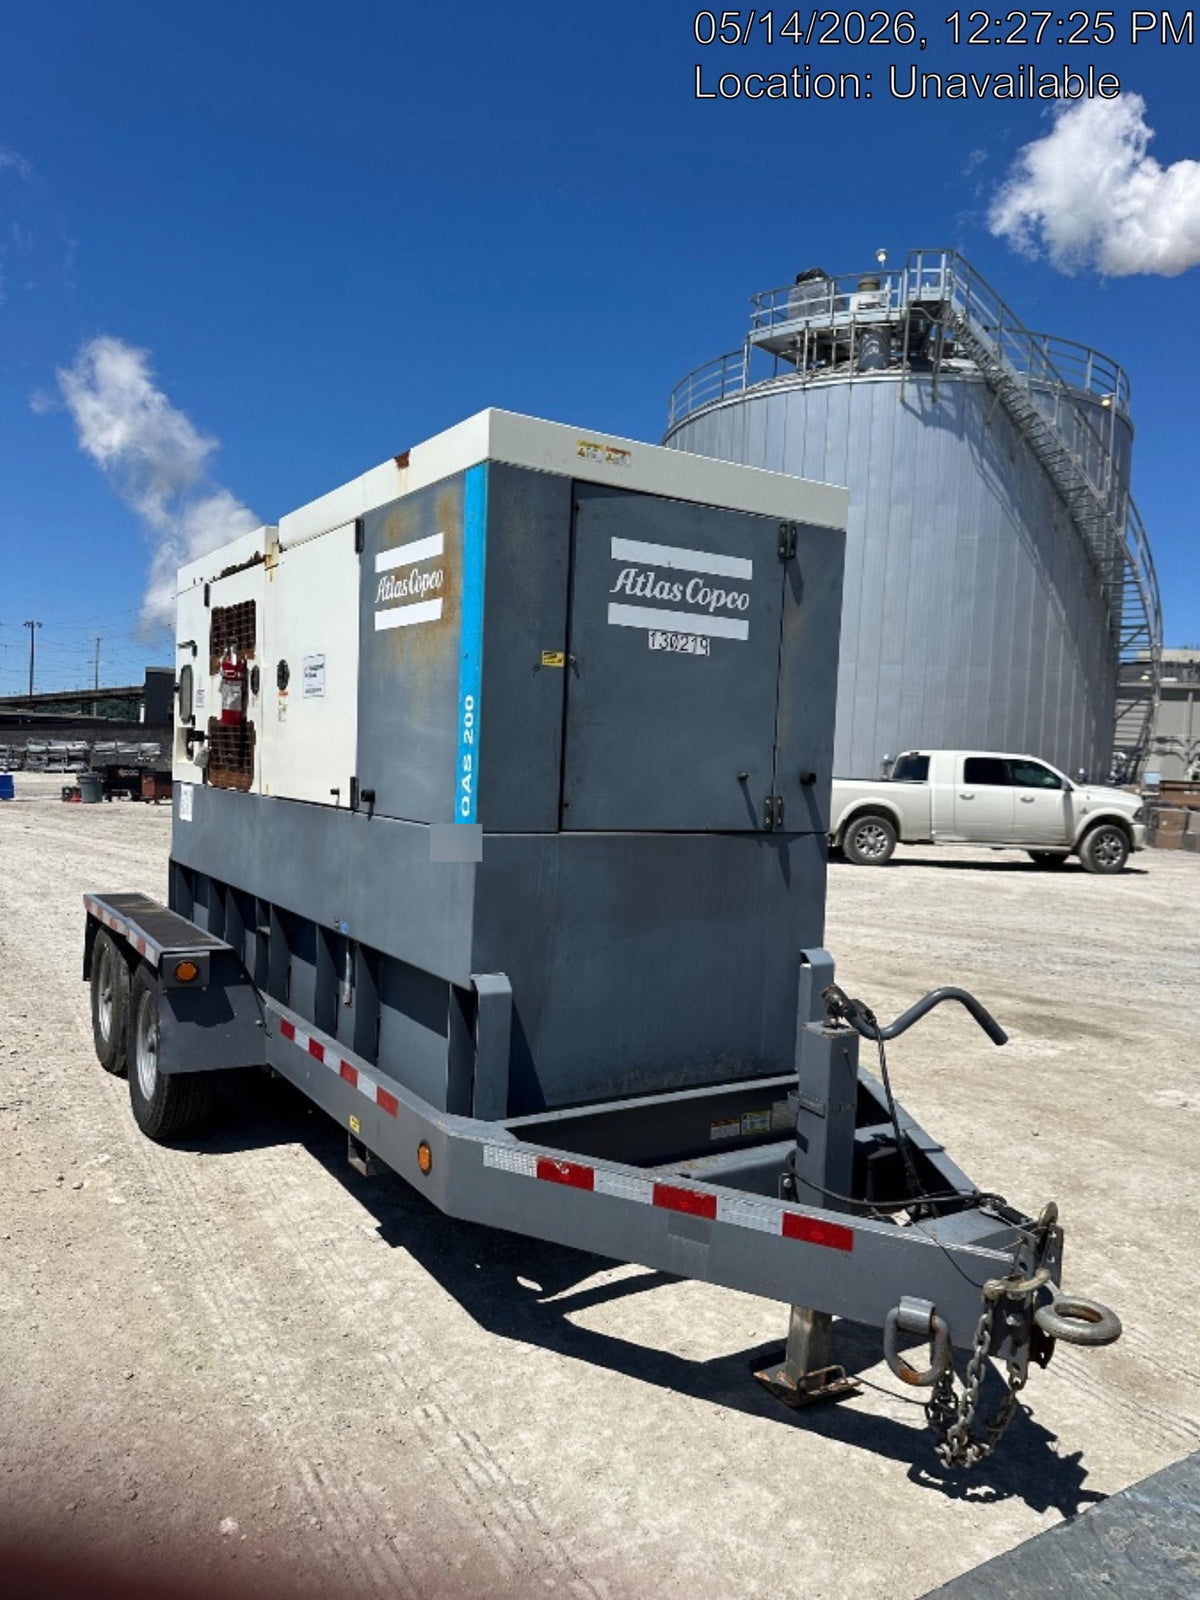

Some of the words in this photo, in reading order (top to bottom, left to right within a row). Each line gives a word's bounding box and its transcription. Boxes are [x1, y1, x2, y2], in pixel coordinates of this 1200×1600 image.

[373, 575, 408, 603] Atlas
[408, 568, 443, 598] Copco
[609, 568, 684, 601] Atlas
[685, 577, 750, 612] Copco
[463, 694, 474, 745] 200
